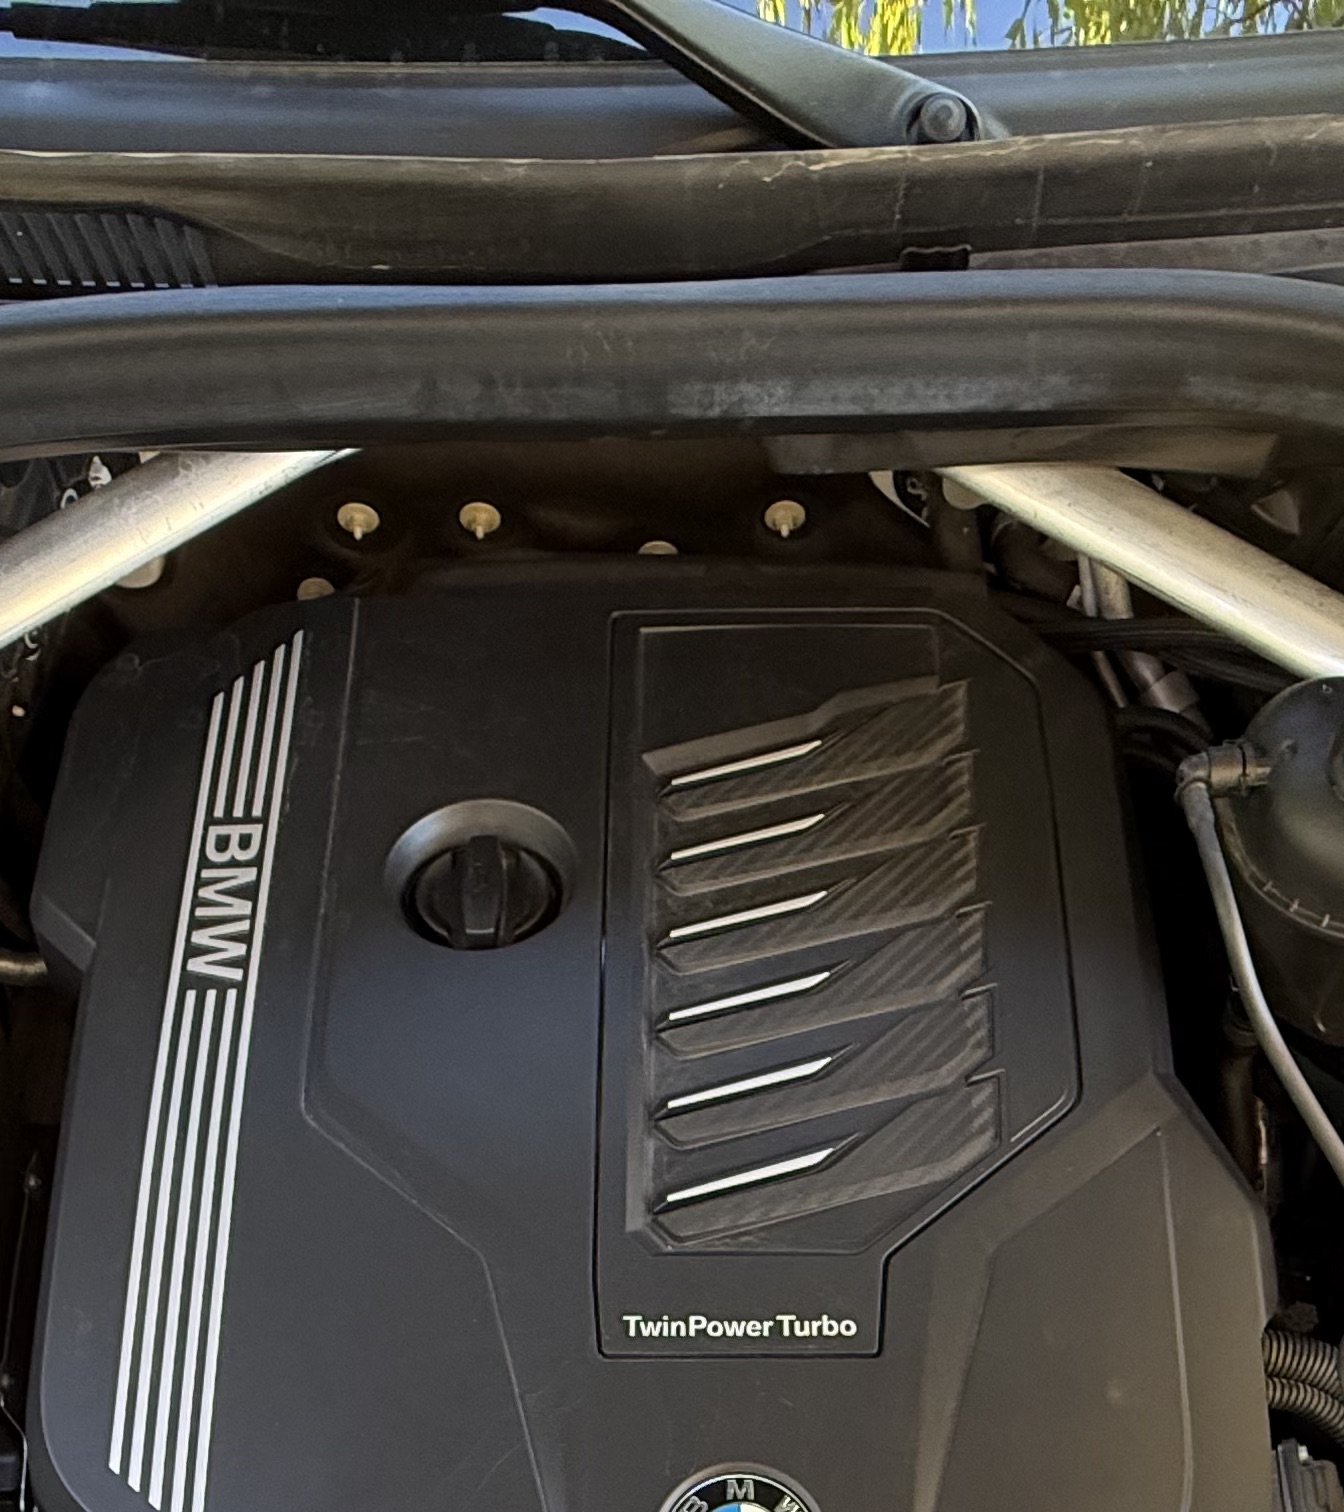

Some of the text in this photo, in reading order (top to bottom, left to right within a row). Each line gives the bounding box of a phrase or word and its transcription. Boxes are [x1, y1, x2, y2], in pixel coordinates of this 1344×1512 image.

[186, 823, 264, 982] BMW
[622, 1314, 857, 1338] TwinPower Turbo
